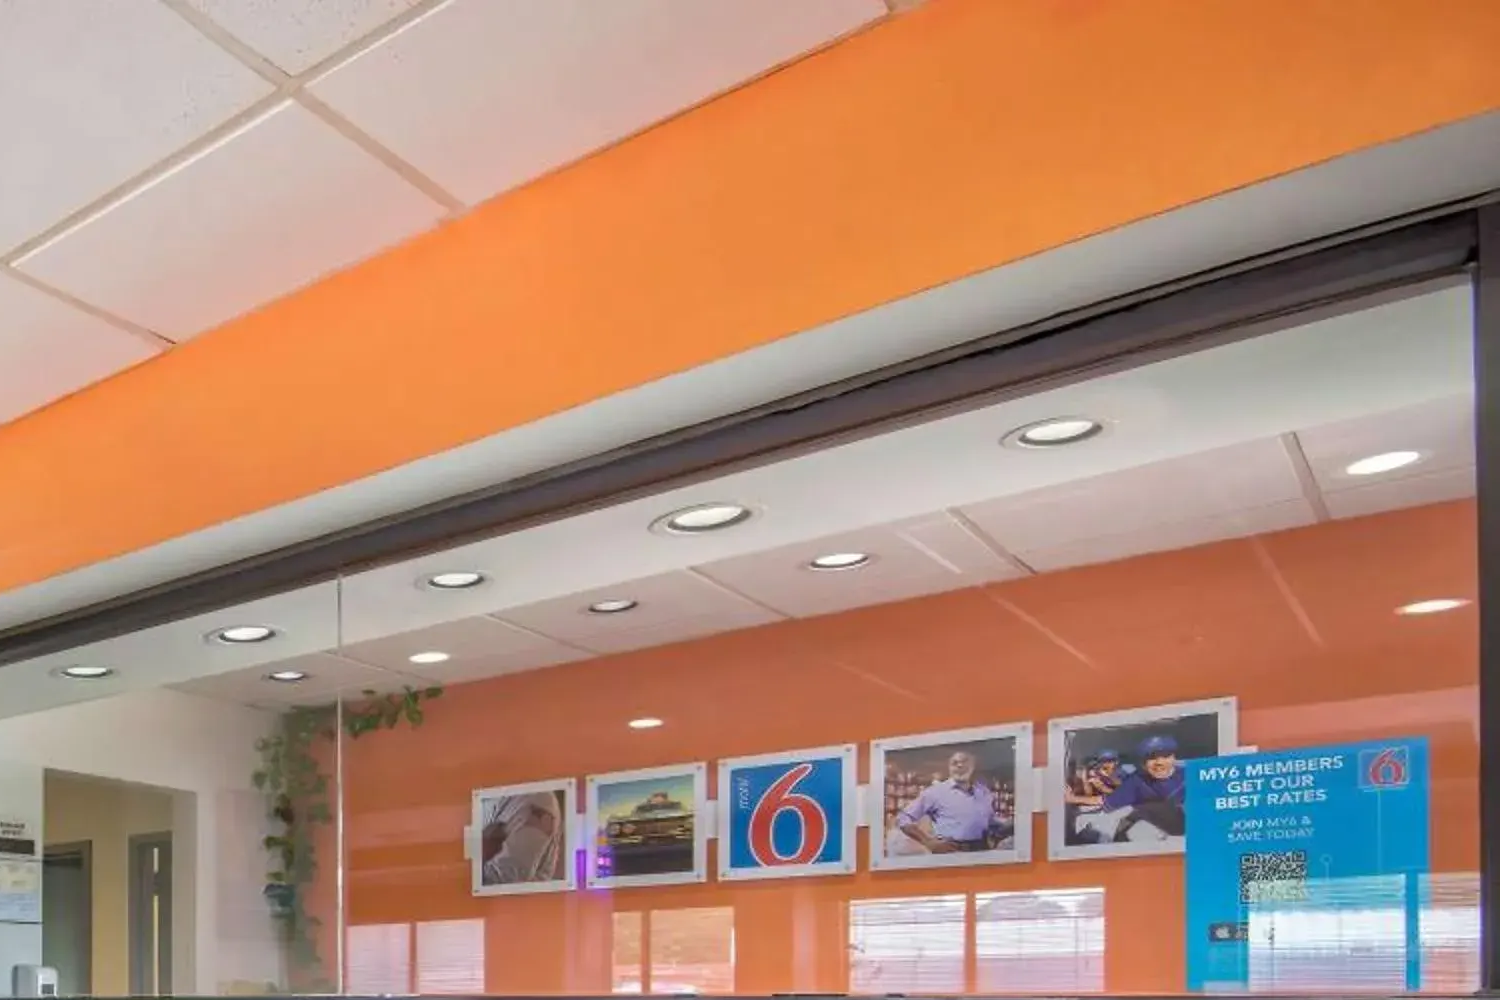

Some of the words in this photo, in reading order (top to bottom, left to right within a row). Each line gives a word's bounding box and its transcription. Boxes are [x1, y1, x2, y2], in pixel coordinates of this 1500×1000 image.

[1199, 766, 1240, 781] MY6
[1245, 755, 1344, 777] MEMBERS
[1369, 748, 1404, 787] 6
[1227, 779, 1264, 793] GET
[1270, 774, 1314, 790] OUR
[1215, 795, 1260, 810] BEST
[1267, 789, 1328, 805] RATES
[748, 763, 827, 867] 6
